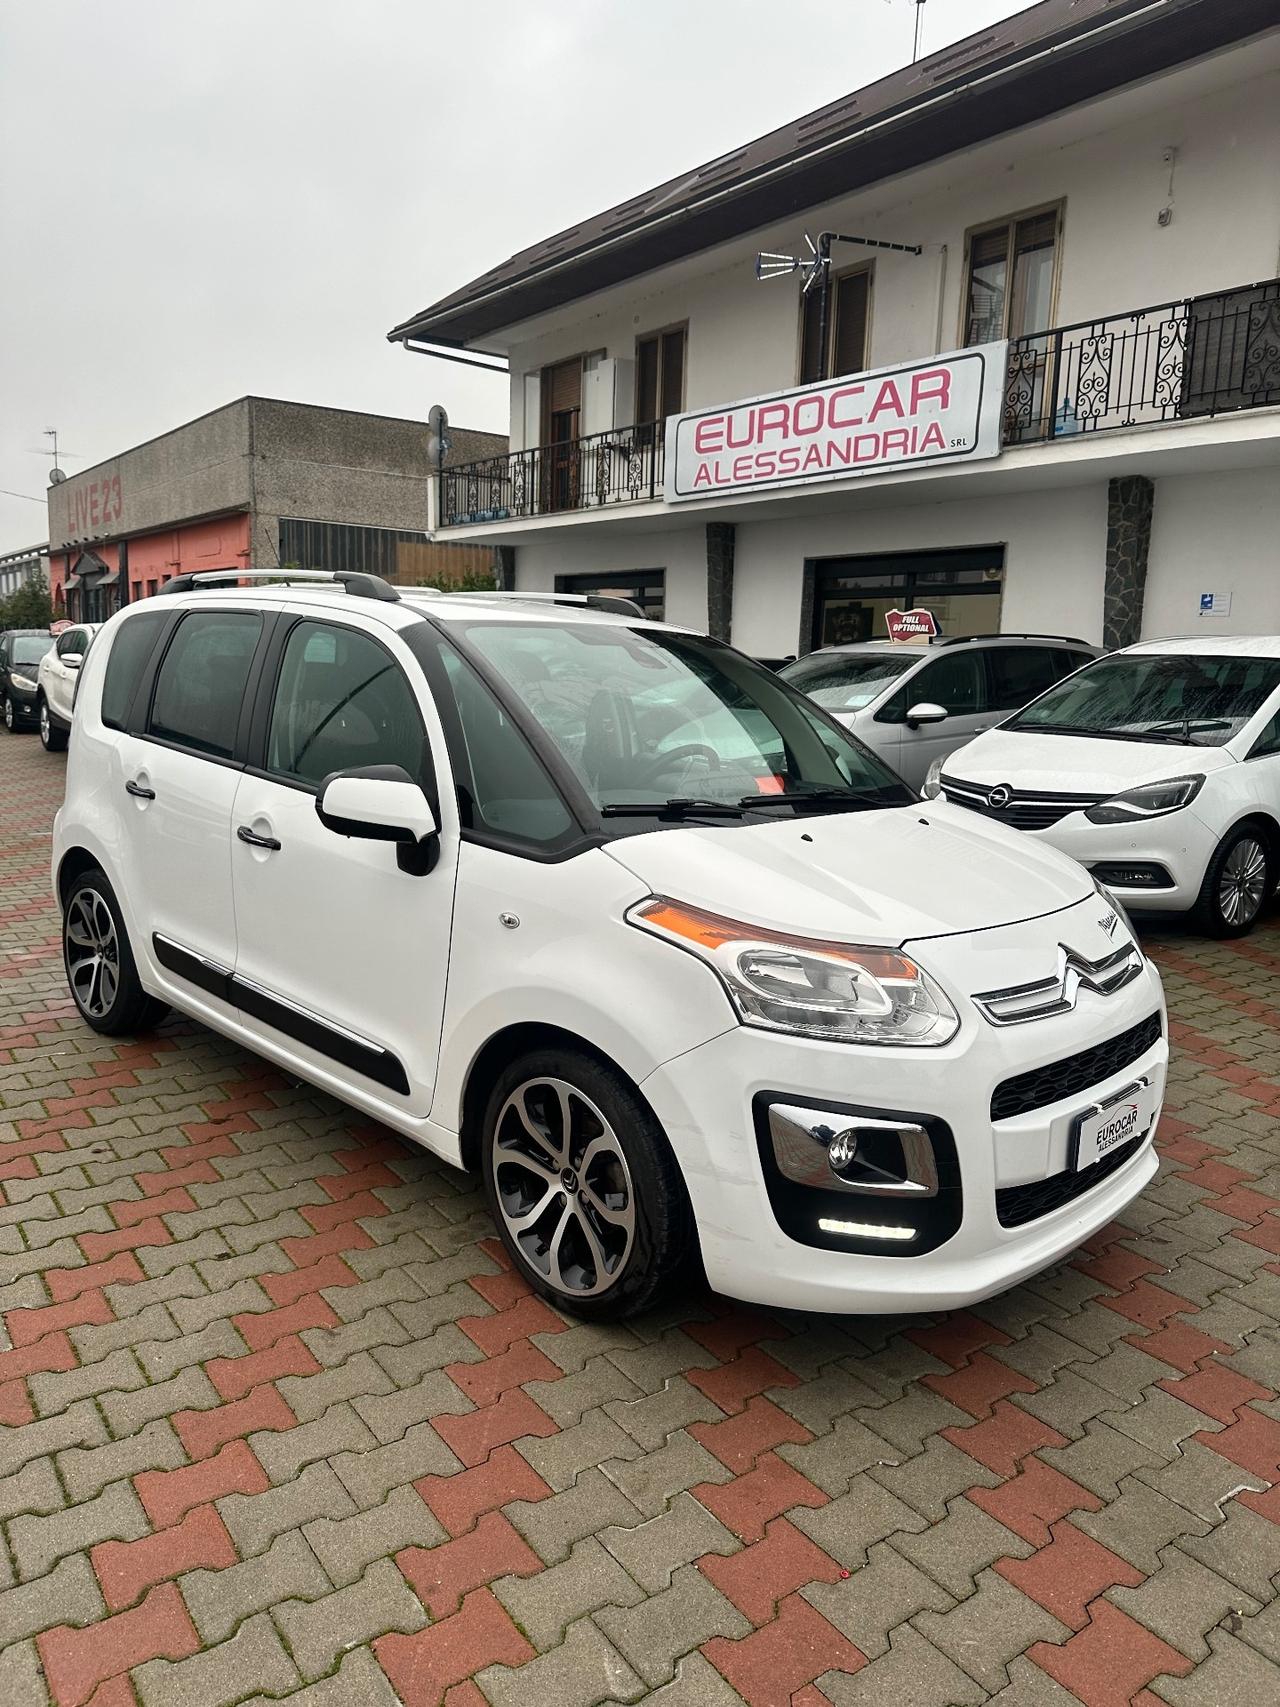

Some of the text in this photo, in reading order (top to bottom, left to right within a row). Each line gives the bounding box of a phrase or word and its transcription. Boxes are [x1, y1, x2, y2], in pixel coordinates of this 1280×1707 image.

[695, 368, 952, 454] EUROCAR
[693, 422, 967, 488] ALESSANDRIA SRL
[892, 623, 930, 632] OPTIONAL
[902, 615, 920, 624] FULL
[1096, 1109, 1138, 1146] EUROCAR
[1098, 1125, 1134, 1153] ALESSANDRIA
